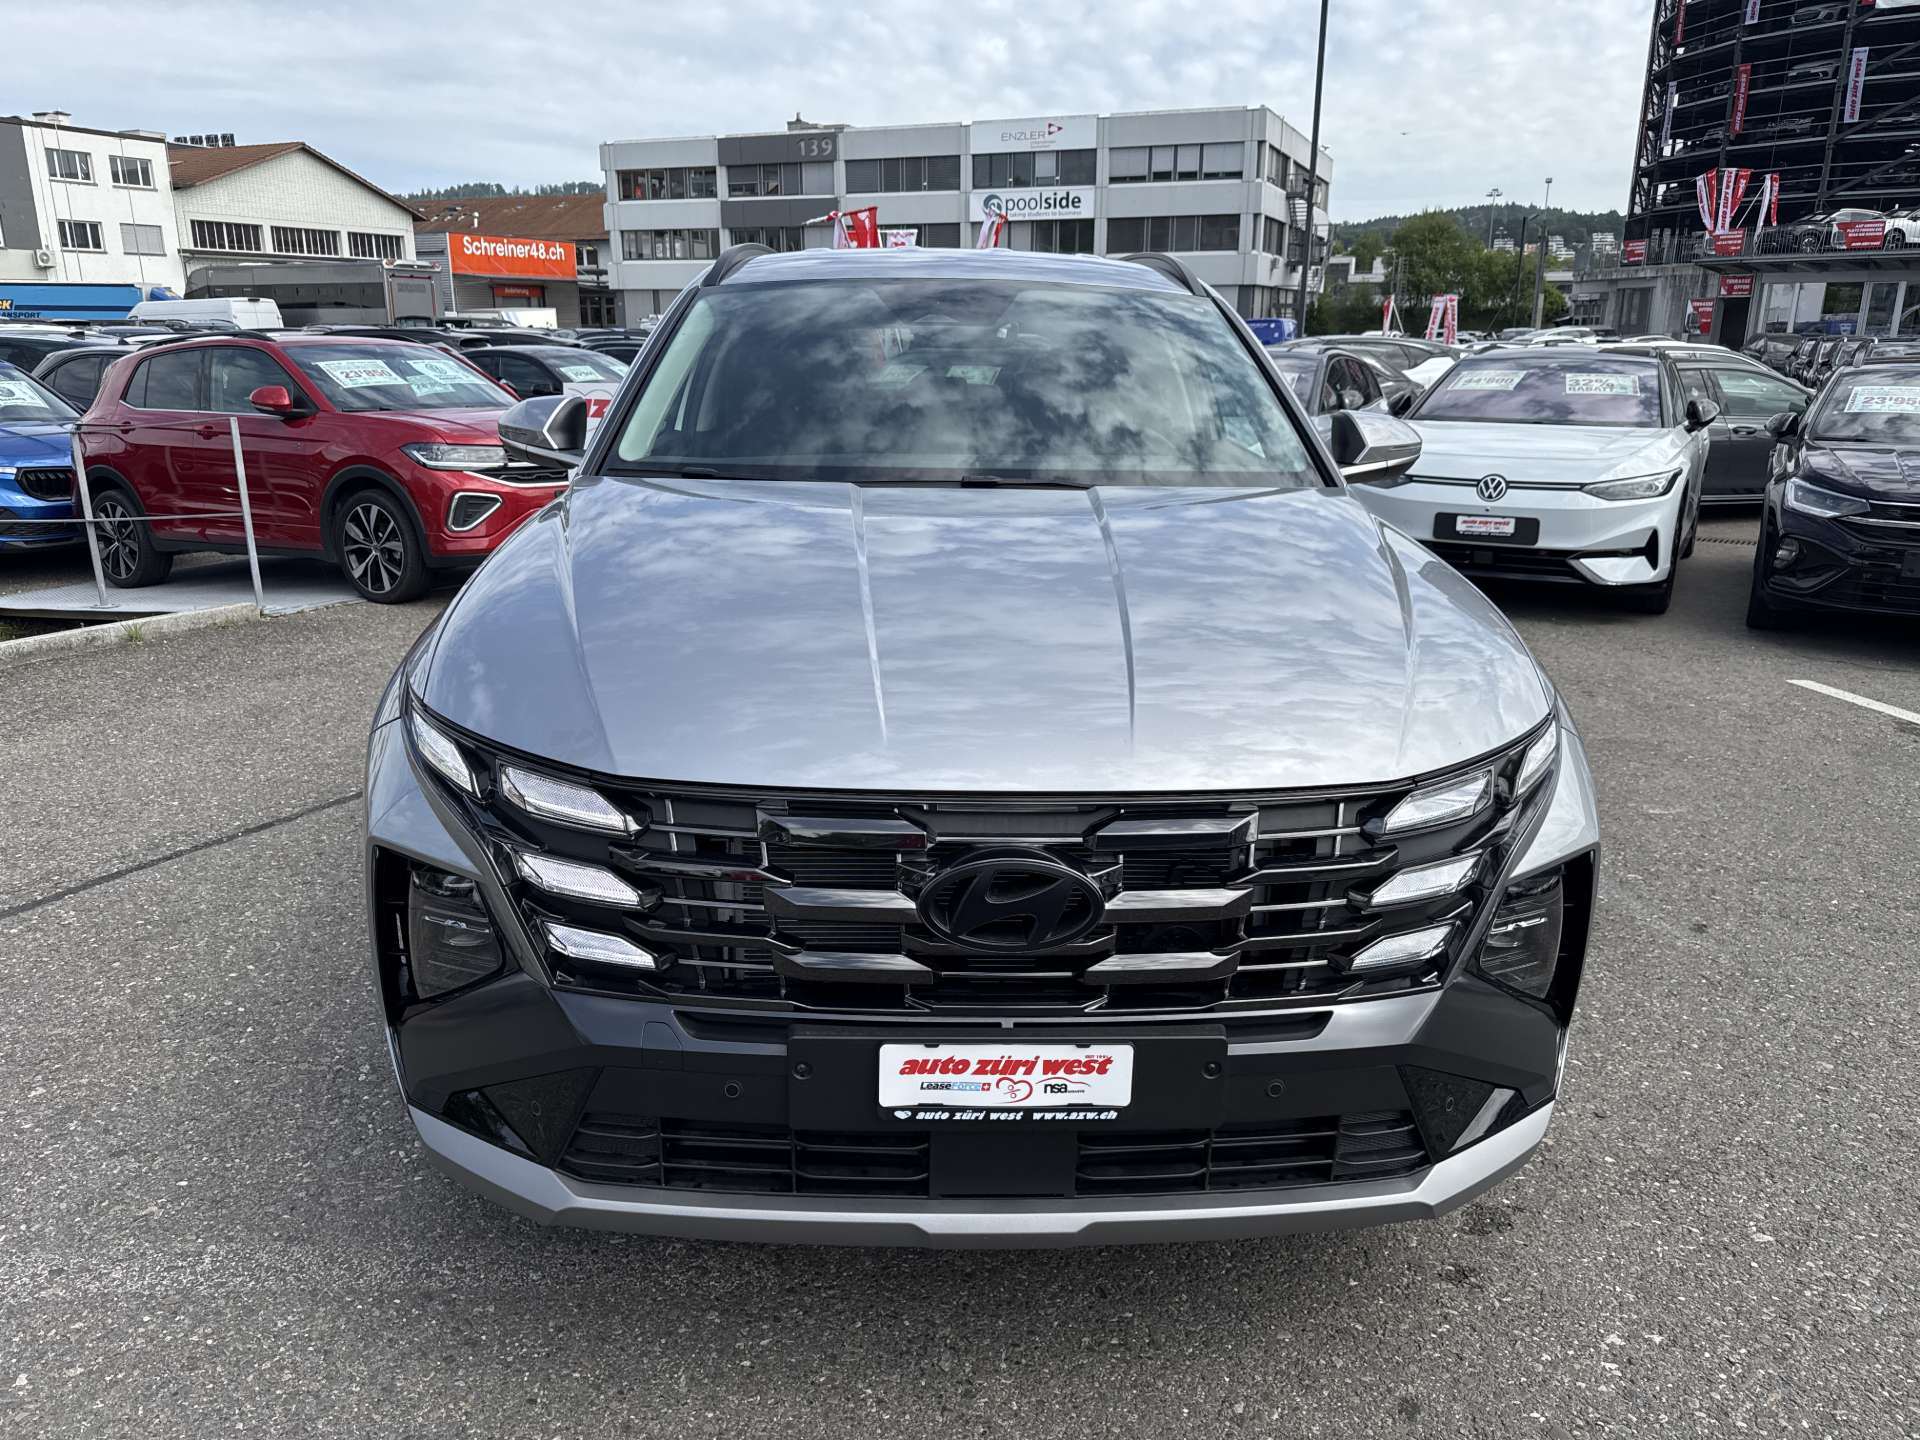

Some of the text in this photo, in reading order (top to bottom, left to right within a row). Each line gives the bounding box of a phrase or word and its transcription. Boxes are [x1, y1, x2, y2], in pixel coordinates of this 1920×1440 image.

[1001, 130, 1046, 141] ENZLER
[799, 139, 833, 156] 139
[1005, 191, 1082, 213] poolside
[463, 236, 565, 260] Schreiner48.ch
[1568, 379, 1616, 389] 32%
[1862, 396, 1920, 406] 23'95
[899, 1056, 1114, 1076] auto züri west
[920, 1081, 981, 1091] LeaseForce
[1044, 1083, 1068, 1094] nsa
[916, 1110, 1118, 1120] auto züri west www.azw.ch
